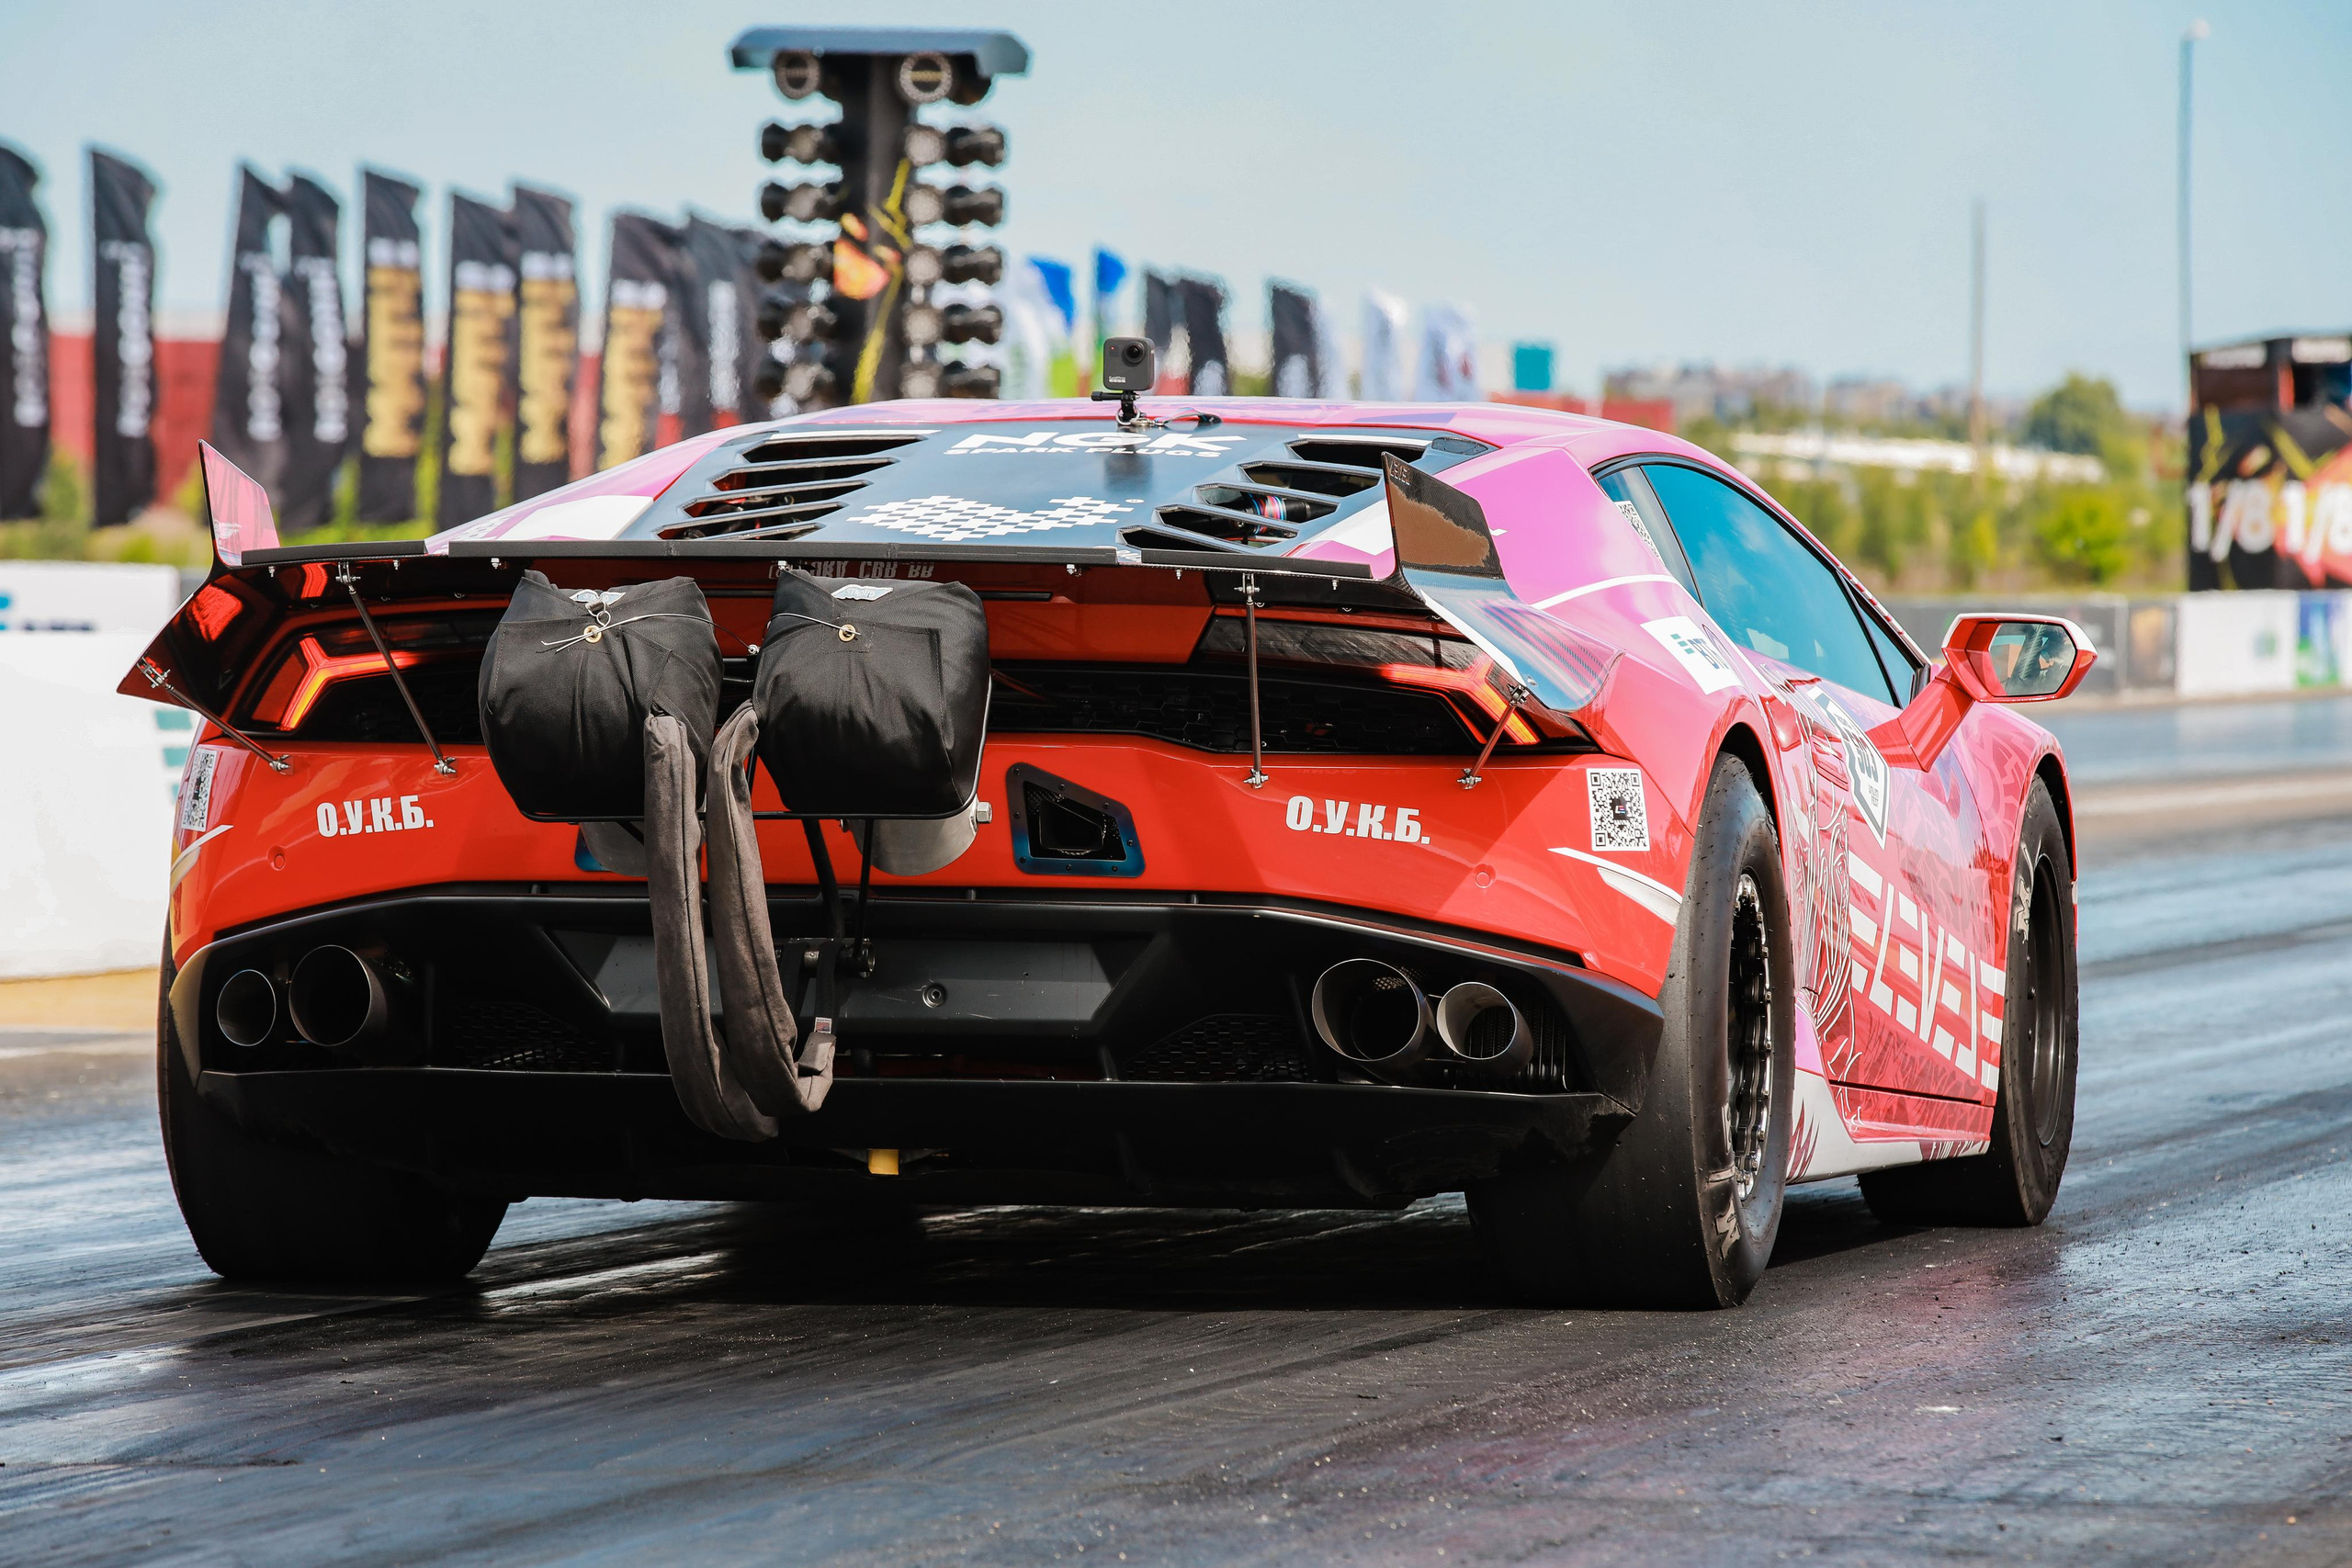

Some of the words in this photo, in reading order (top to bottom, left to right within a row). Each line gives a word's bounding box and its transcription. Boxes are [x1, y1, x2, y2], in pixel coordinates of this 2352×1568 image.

[951, 432, 1248, 451] NGK
[1085, 447, 1223, 457] PLUGS
[2186, 479, 2277, 563] 1/8
[316, 795, 435, 838] О.У.К.Б.
[1285, 795, 1430, 844] О.У.К.Б.
